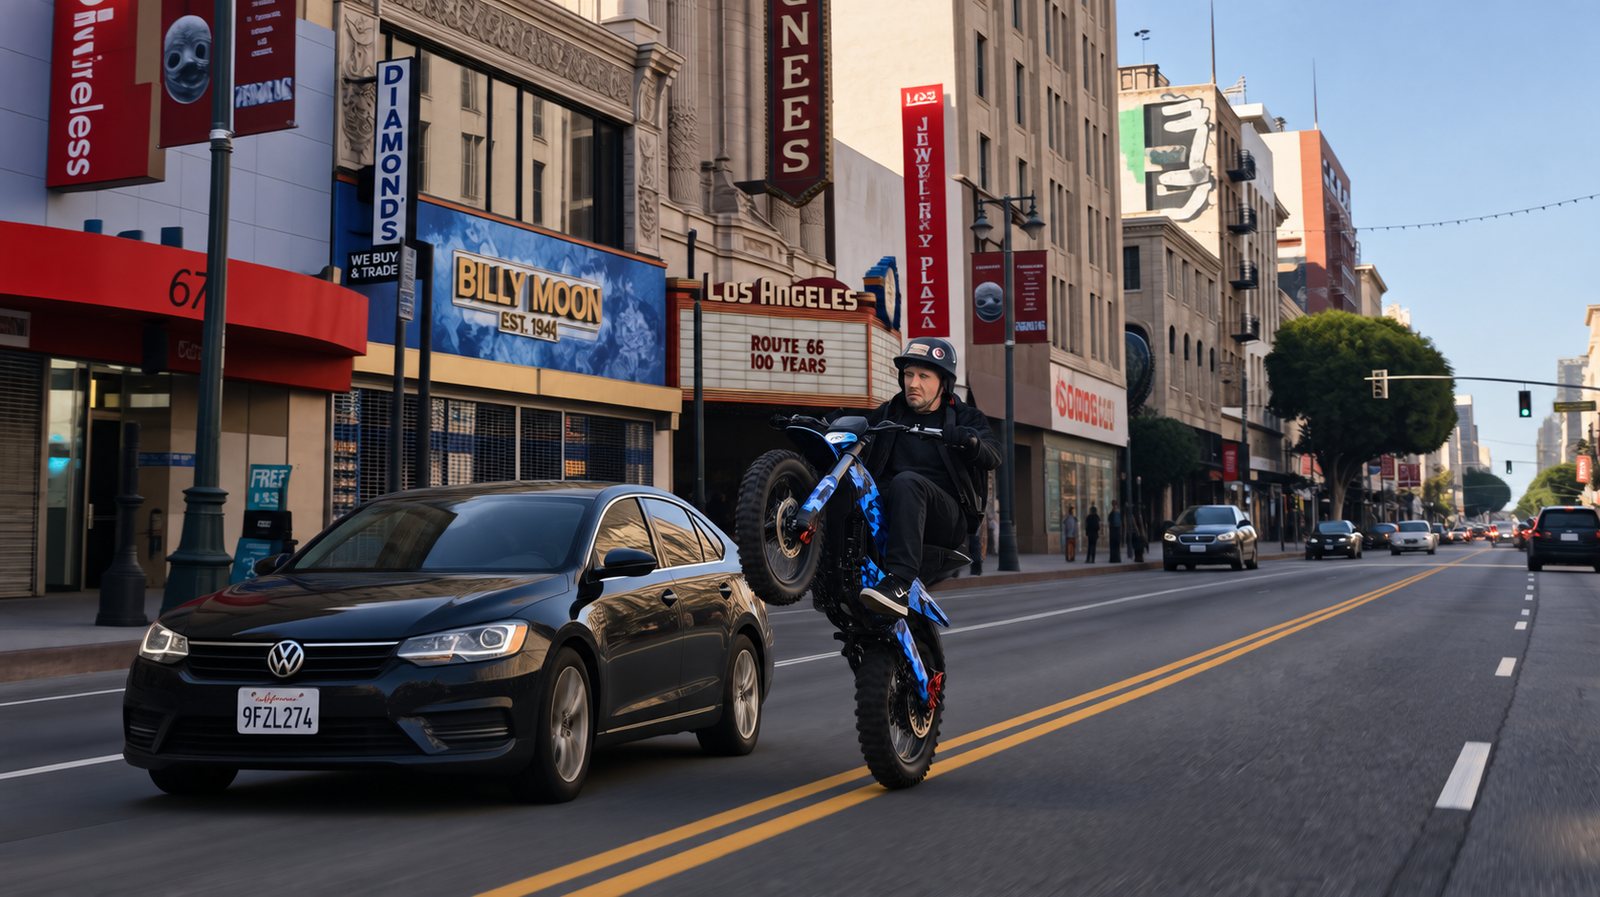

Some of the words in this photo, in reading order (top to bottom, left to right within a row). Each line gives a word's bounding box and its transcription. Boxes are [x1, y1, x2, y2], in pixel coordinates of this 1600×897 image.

[780, 0, 811, 173] NEES
[351, 253, 371, 266] WE
[372, 251, 399, 264] BUY
[350, 267, 360, 279] &
[361, 264, 399, 278] TRADE
[456, 256, 527, 307] BILLY
[529, 274, 602, 324] MOON
[920, 256, 937, 329] PLAZA
[500, 311, 529, 334] EST.
[530, 317, 558, 341] 1944
[750, 334, 800, 354] ROUTE
[806, 338, 825, 356] 66
[750, 353, 774, 370] 100
[780, 355, 827, 374] YEARS
[242, 706, 313, 729] 9FZL274
